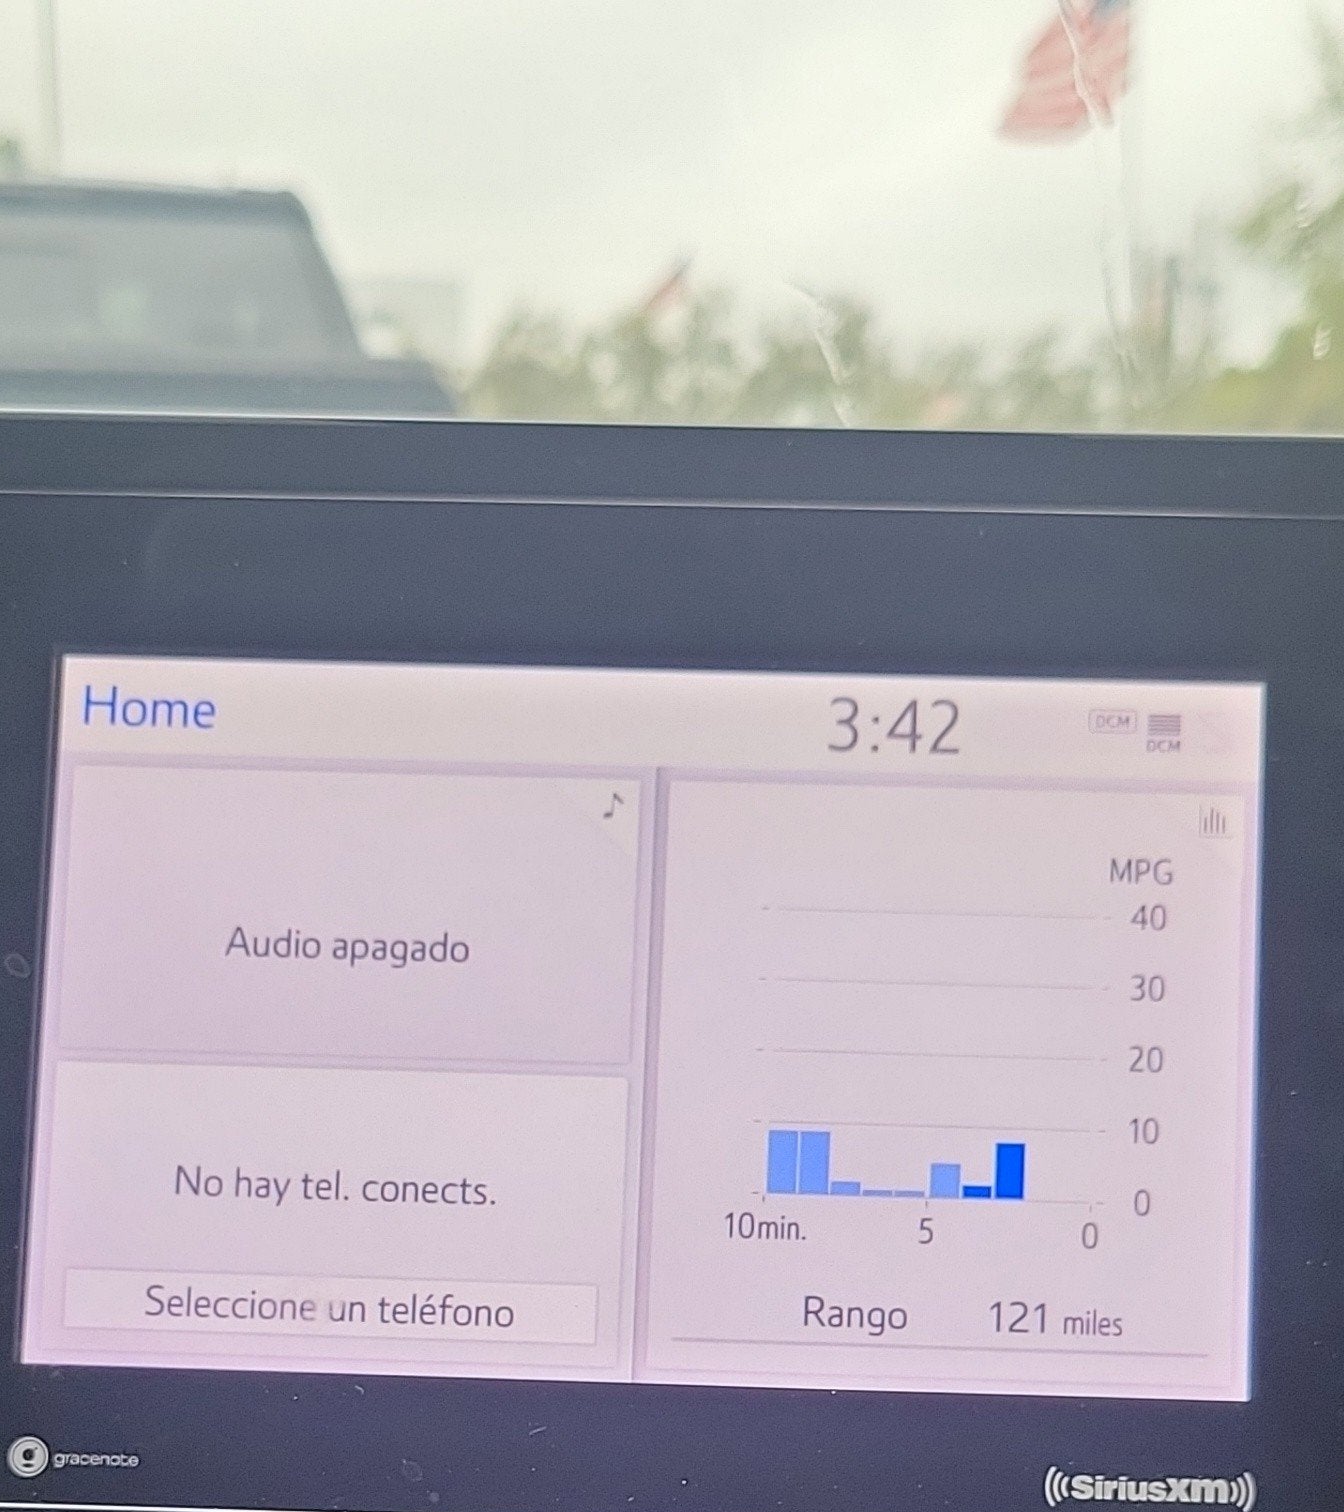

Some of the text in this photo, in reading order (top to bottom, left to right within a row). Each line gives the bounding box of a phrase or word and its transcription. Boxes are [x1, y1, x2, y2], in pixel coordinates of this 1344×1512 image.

[80, 685, 218, 732] Home
[825, 696, 962, 756] 3:42
[1107, 857, 1175, 886] MPG
[1129, 904, 1168, 931] 40
[224, 926, 471, 969] Audio apagado
[1129, 975, 1166, 1002] 30
[1129, 1046, 1164, 1073] 20
[1129, 1117, 1159, 1145] 10
[174, 1165, 497, 1206] No hay tel. conects.
[1134, 1190, 1151, 1217] 0
[918, 1218, 934, 1244] 5
[1081, 1222, 1099, 1250] 0
[144, 1284, 515, 1328] Seleccione un teléfono
[803, 1296, 1123, 1337] Rango 121 miles
[53, 1453, 140, 1468] gracenote
